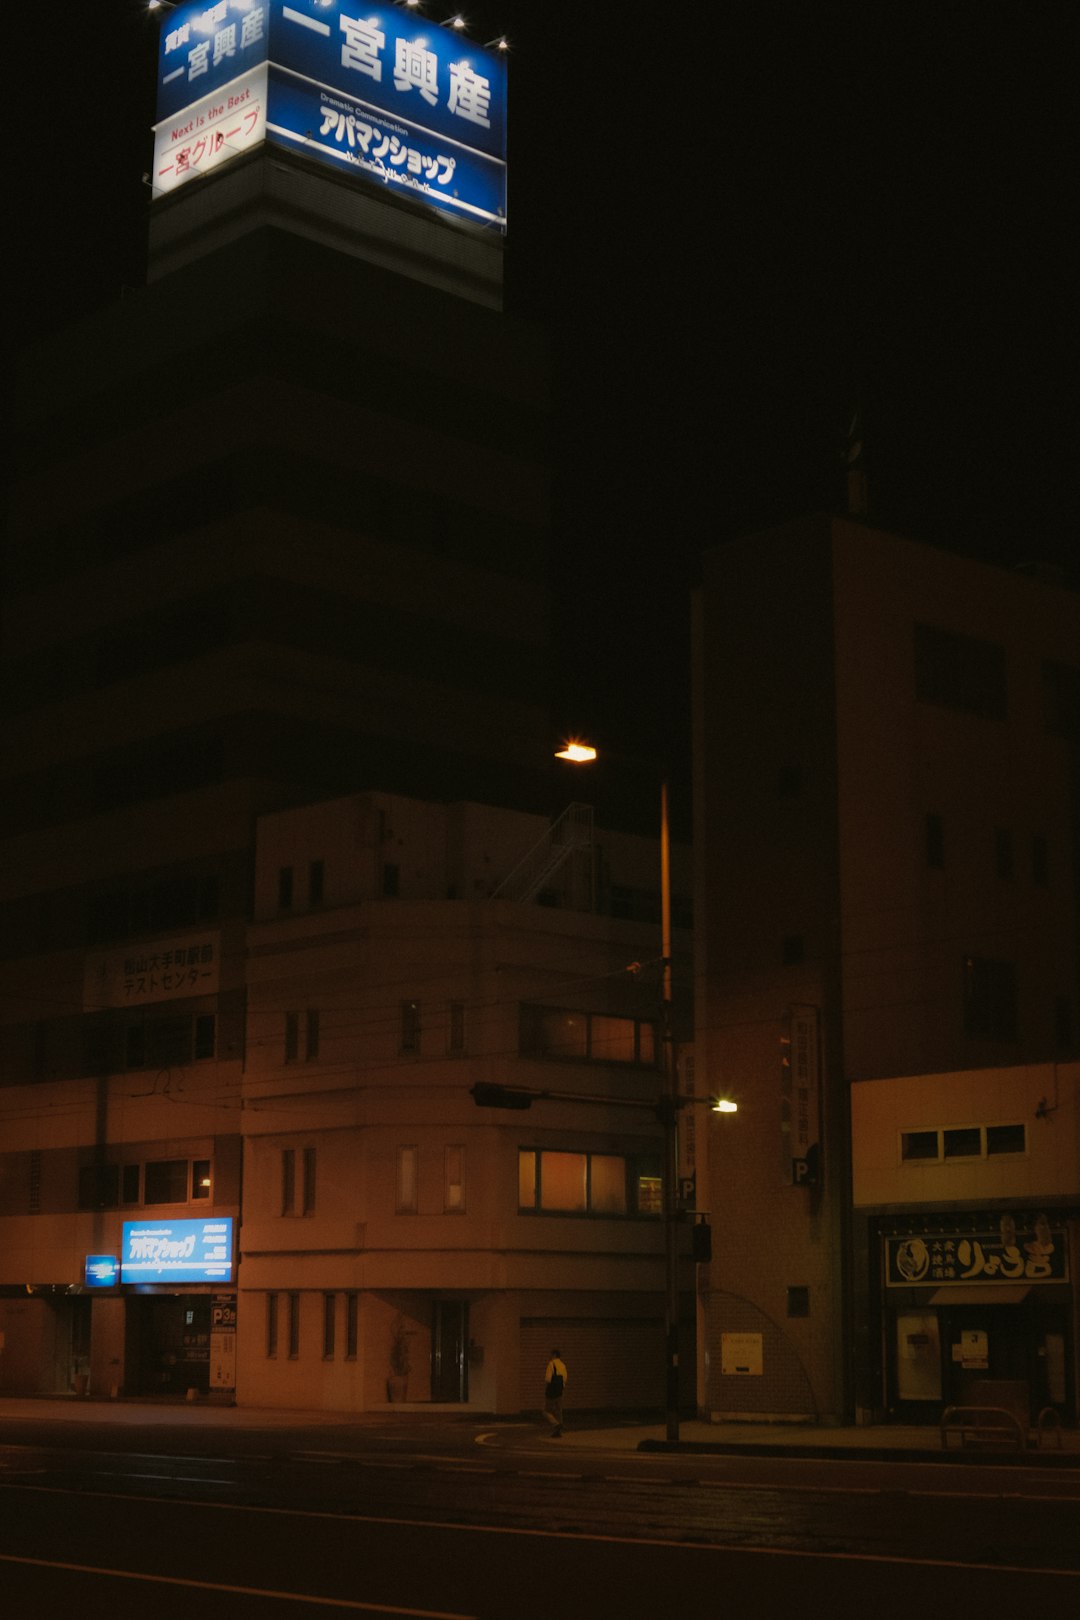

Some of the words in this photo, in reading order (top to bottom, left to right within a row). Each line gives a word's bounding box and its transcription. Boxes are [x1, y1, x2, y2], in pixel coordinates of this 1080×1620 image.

[162, 7, 264, 85] 一宮興産
[282, 5, 491, 130] 一宮興産
[171, 120, 194, 142] Next
[207, 106, 225, 121] the
[227, 88, 250, 110] Best
[320, 92, 355, 113] Dramatic
[355, 107, 409, 137] Communication
[158, 106, 261, 177] 一宮グループ
[319, 105, 457, 185] アパマンショップ
[123, 967, 212, 996] テストセンター
[682, 1180, 694, 1199] P
[796, 1161, 809, 1182] P
[213, 1308, 223, 1324] P
